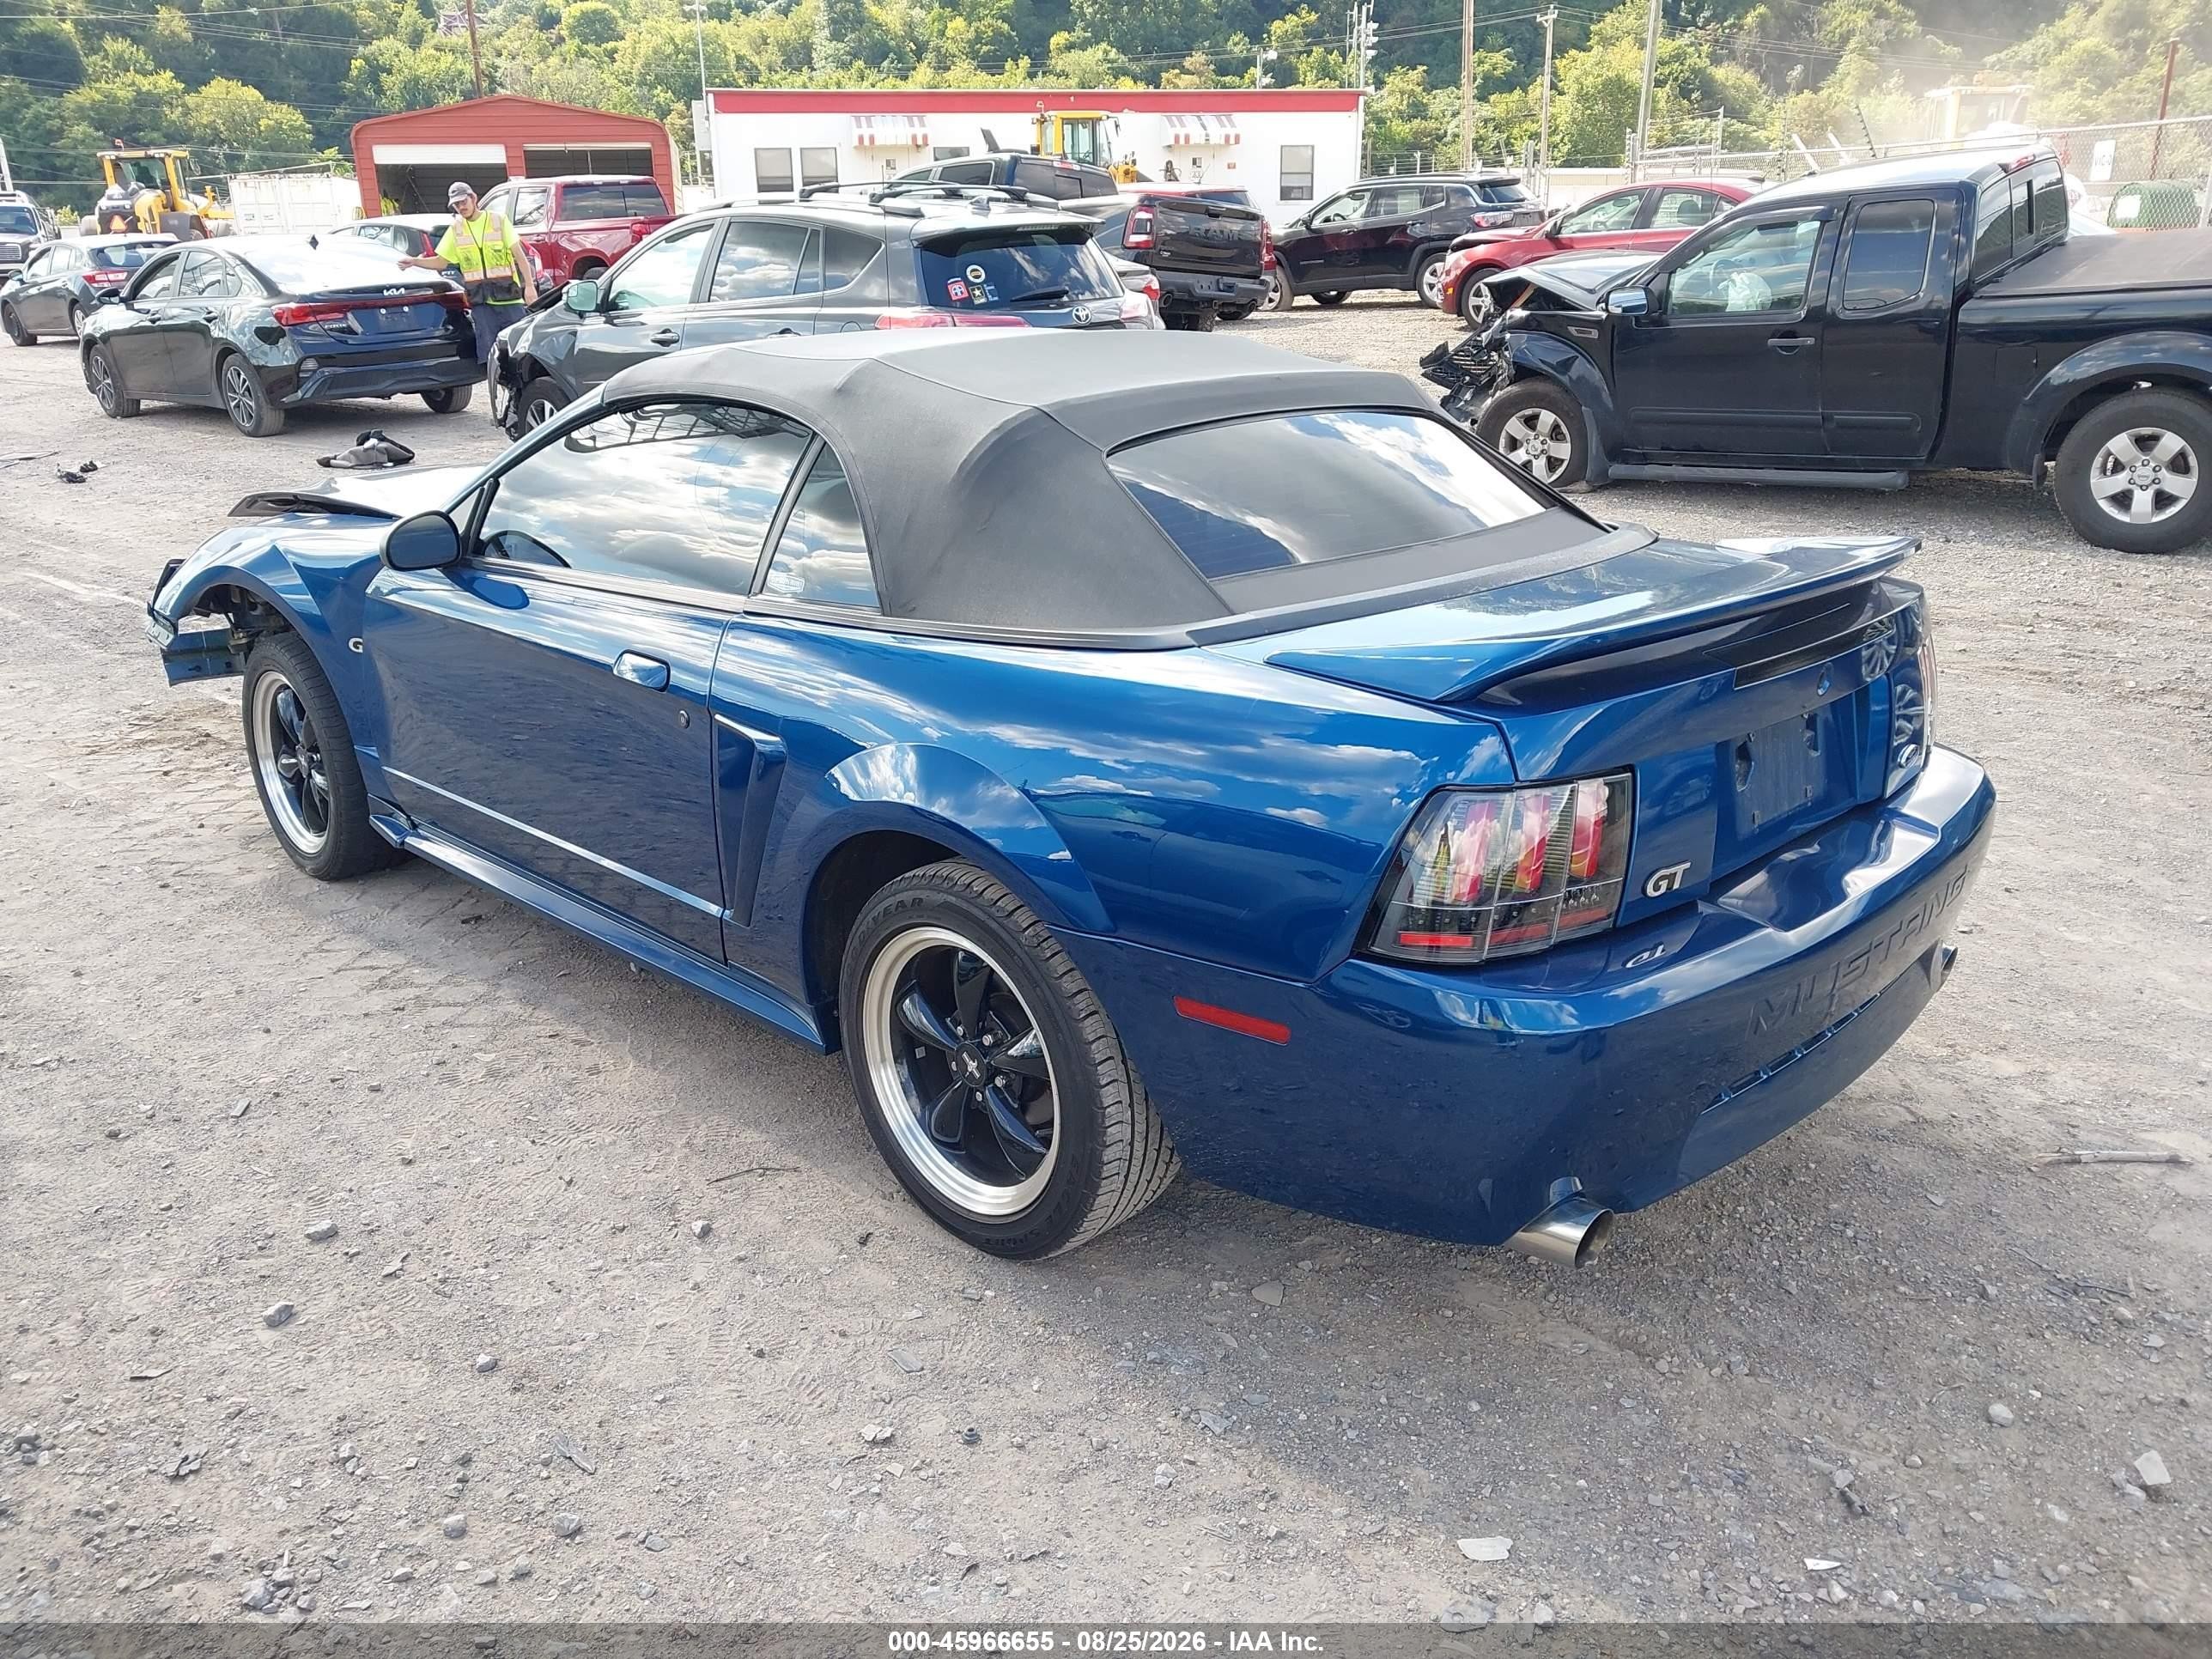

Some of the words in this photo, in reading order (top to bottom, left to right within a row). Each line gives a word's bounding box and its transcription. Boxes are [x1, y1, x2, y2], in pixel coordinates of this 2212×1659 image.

[1189, 226, 1238, 241] RAM
[1645, 860, 1692, 899] GT
[1746, 863, 1971, 1036] MUSTANG
